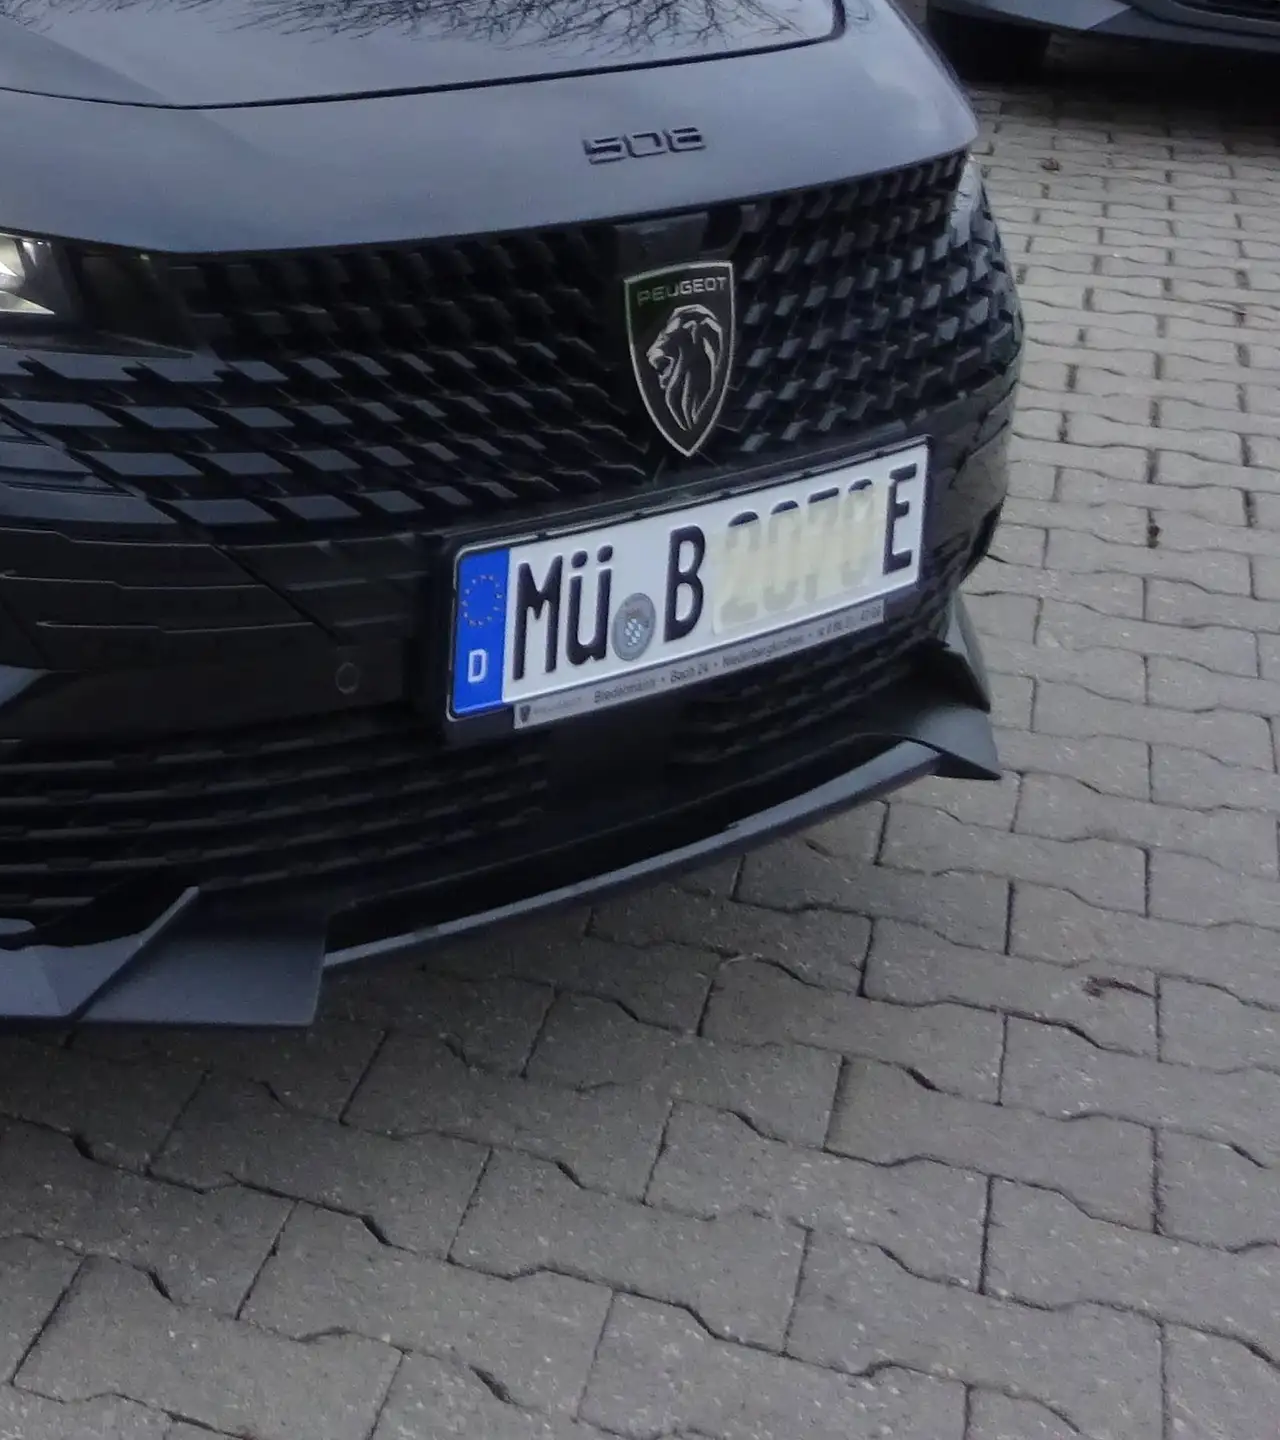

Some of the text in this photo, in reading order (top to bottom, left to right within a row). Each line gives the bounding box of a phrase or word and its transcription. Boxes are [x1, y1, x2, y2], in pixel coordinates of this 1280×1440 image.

[582, 126, 706, 165] 508
[636, 276, 728, 306] PEUGEOT
[467, 648, 487, 683] D
[663, 524, 706, 643] B
